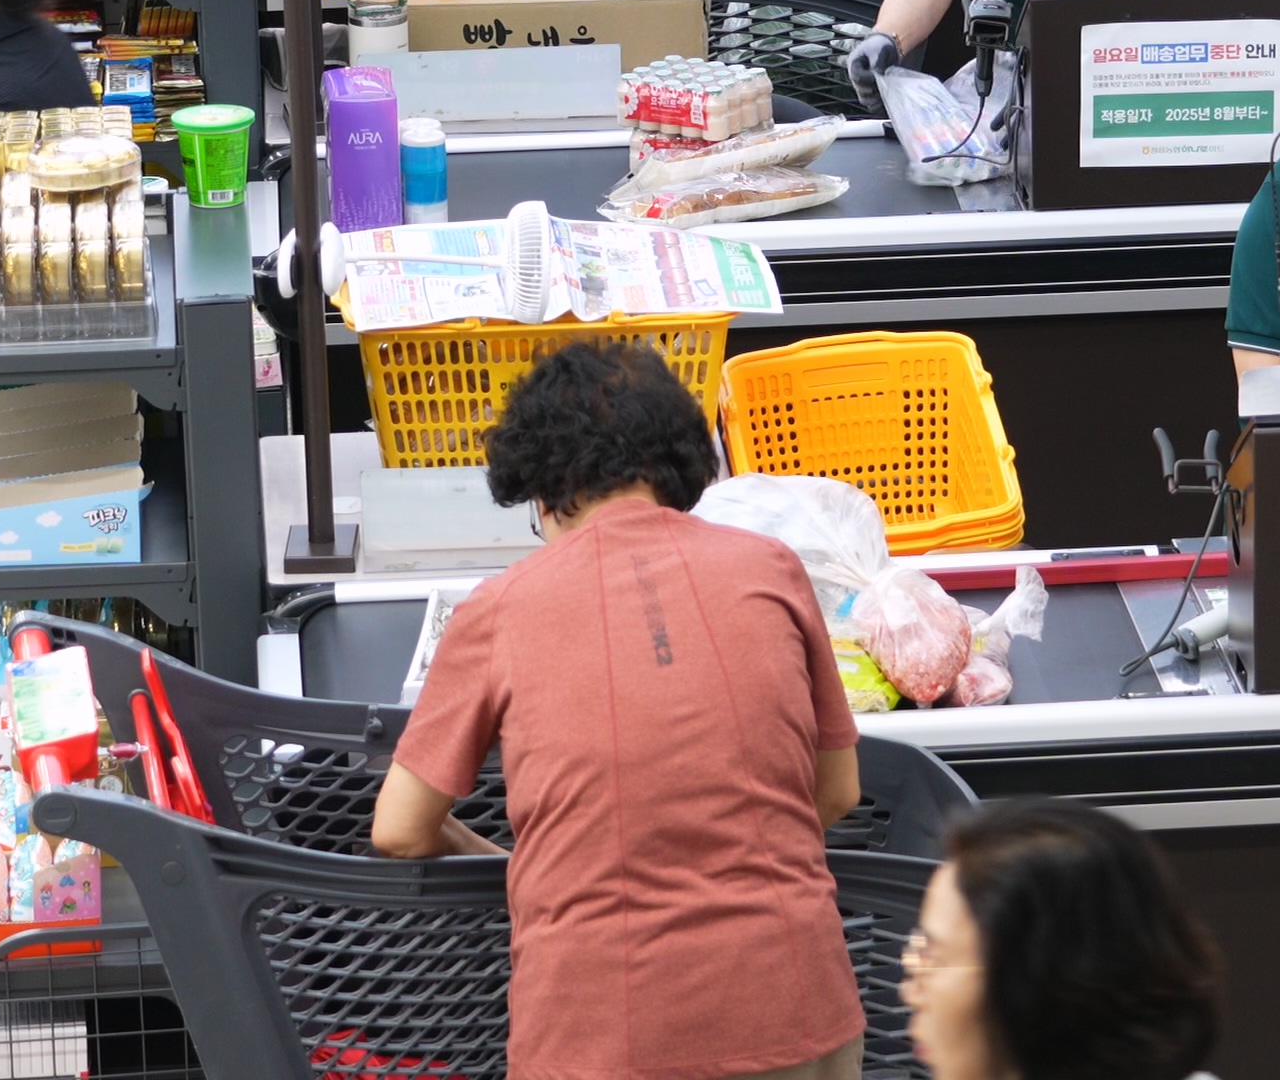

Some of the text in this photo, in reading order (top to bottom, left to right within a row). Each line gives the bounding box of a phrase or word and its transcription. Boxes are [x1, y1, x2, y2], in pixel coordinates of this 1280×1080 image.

[1093, 43, 1276, 63] 일요일 배송업무 중단 안내
[1101, 105, 1268, 125] 적용일자 2025년 8월부터~
[347, 131, 383, 145] AURA
[82, 503, 128, 529] 피크닉
